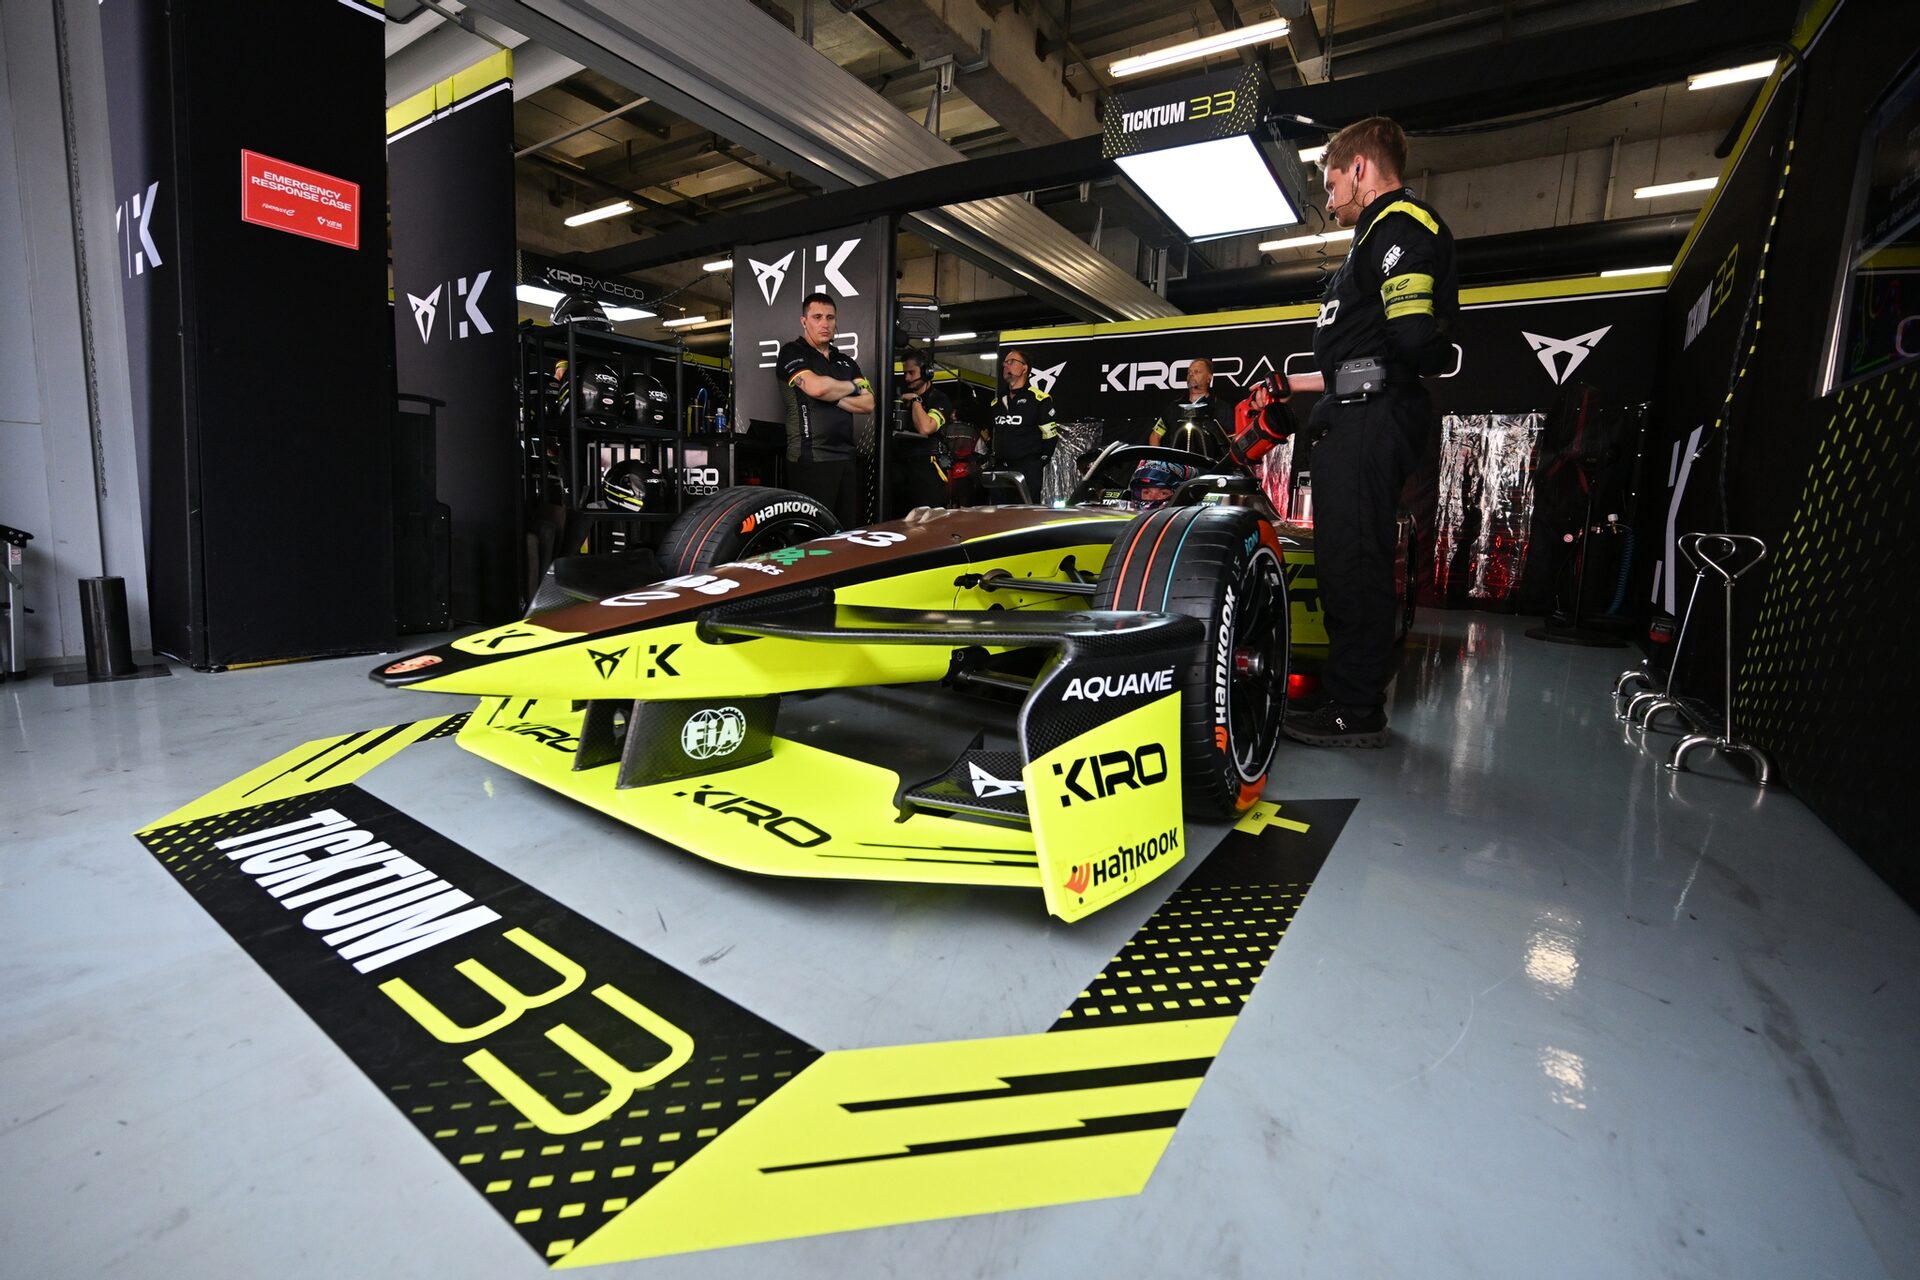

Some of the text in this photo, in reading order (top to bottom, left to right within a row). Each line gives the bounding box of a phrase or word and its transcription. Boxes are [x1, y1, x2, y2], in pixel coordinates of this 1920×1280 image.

[1122, 91, 1236, 134] TICKTUM 33
[251, 175, 352, 212] RESPONSE CASE
[263, 170, 341, 200] EMERGENCY
[1062, 668, 1175, 702] AQUAME
[1052, 742, 1168, 808] KIRO
[672, 784, 832, 848] KIRO
[214, 808, 694, 1135] TICKTUM 33
